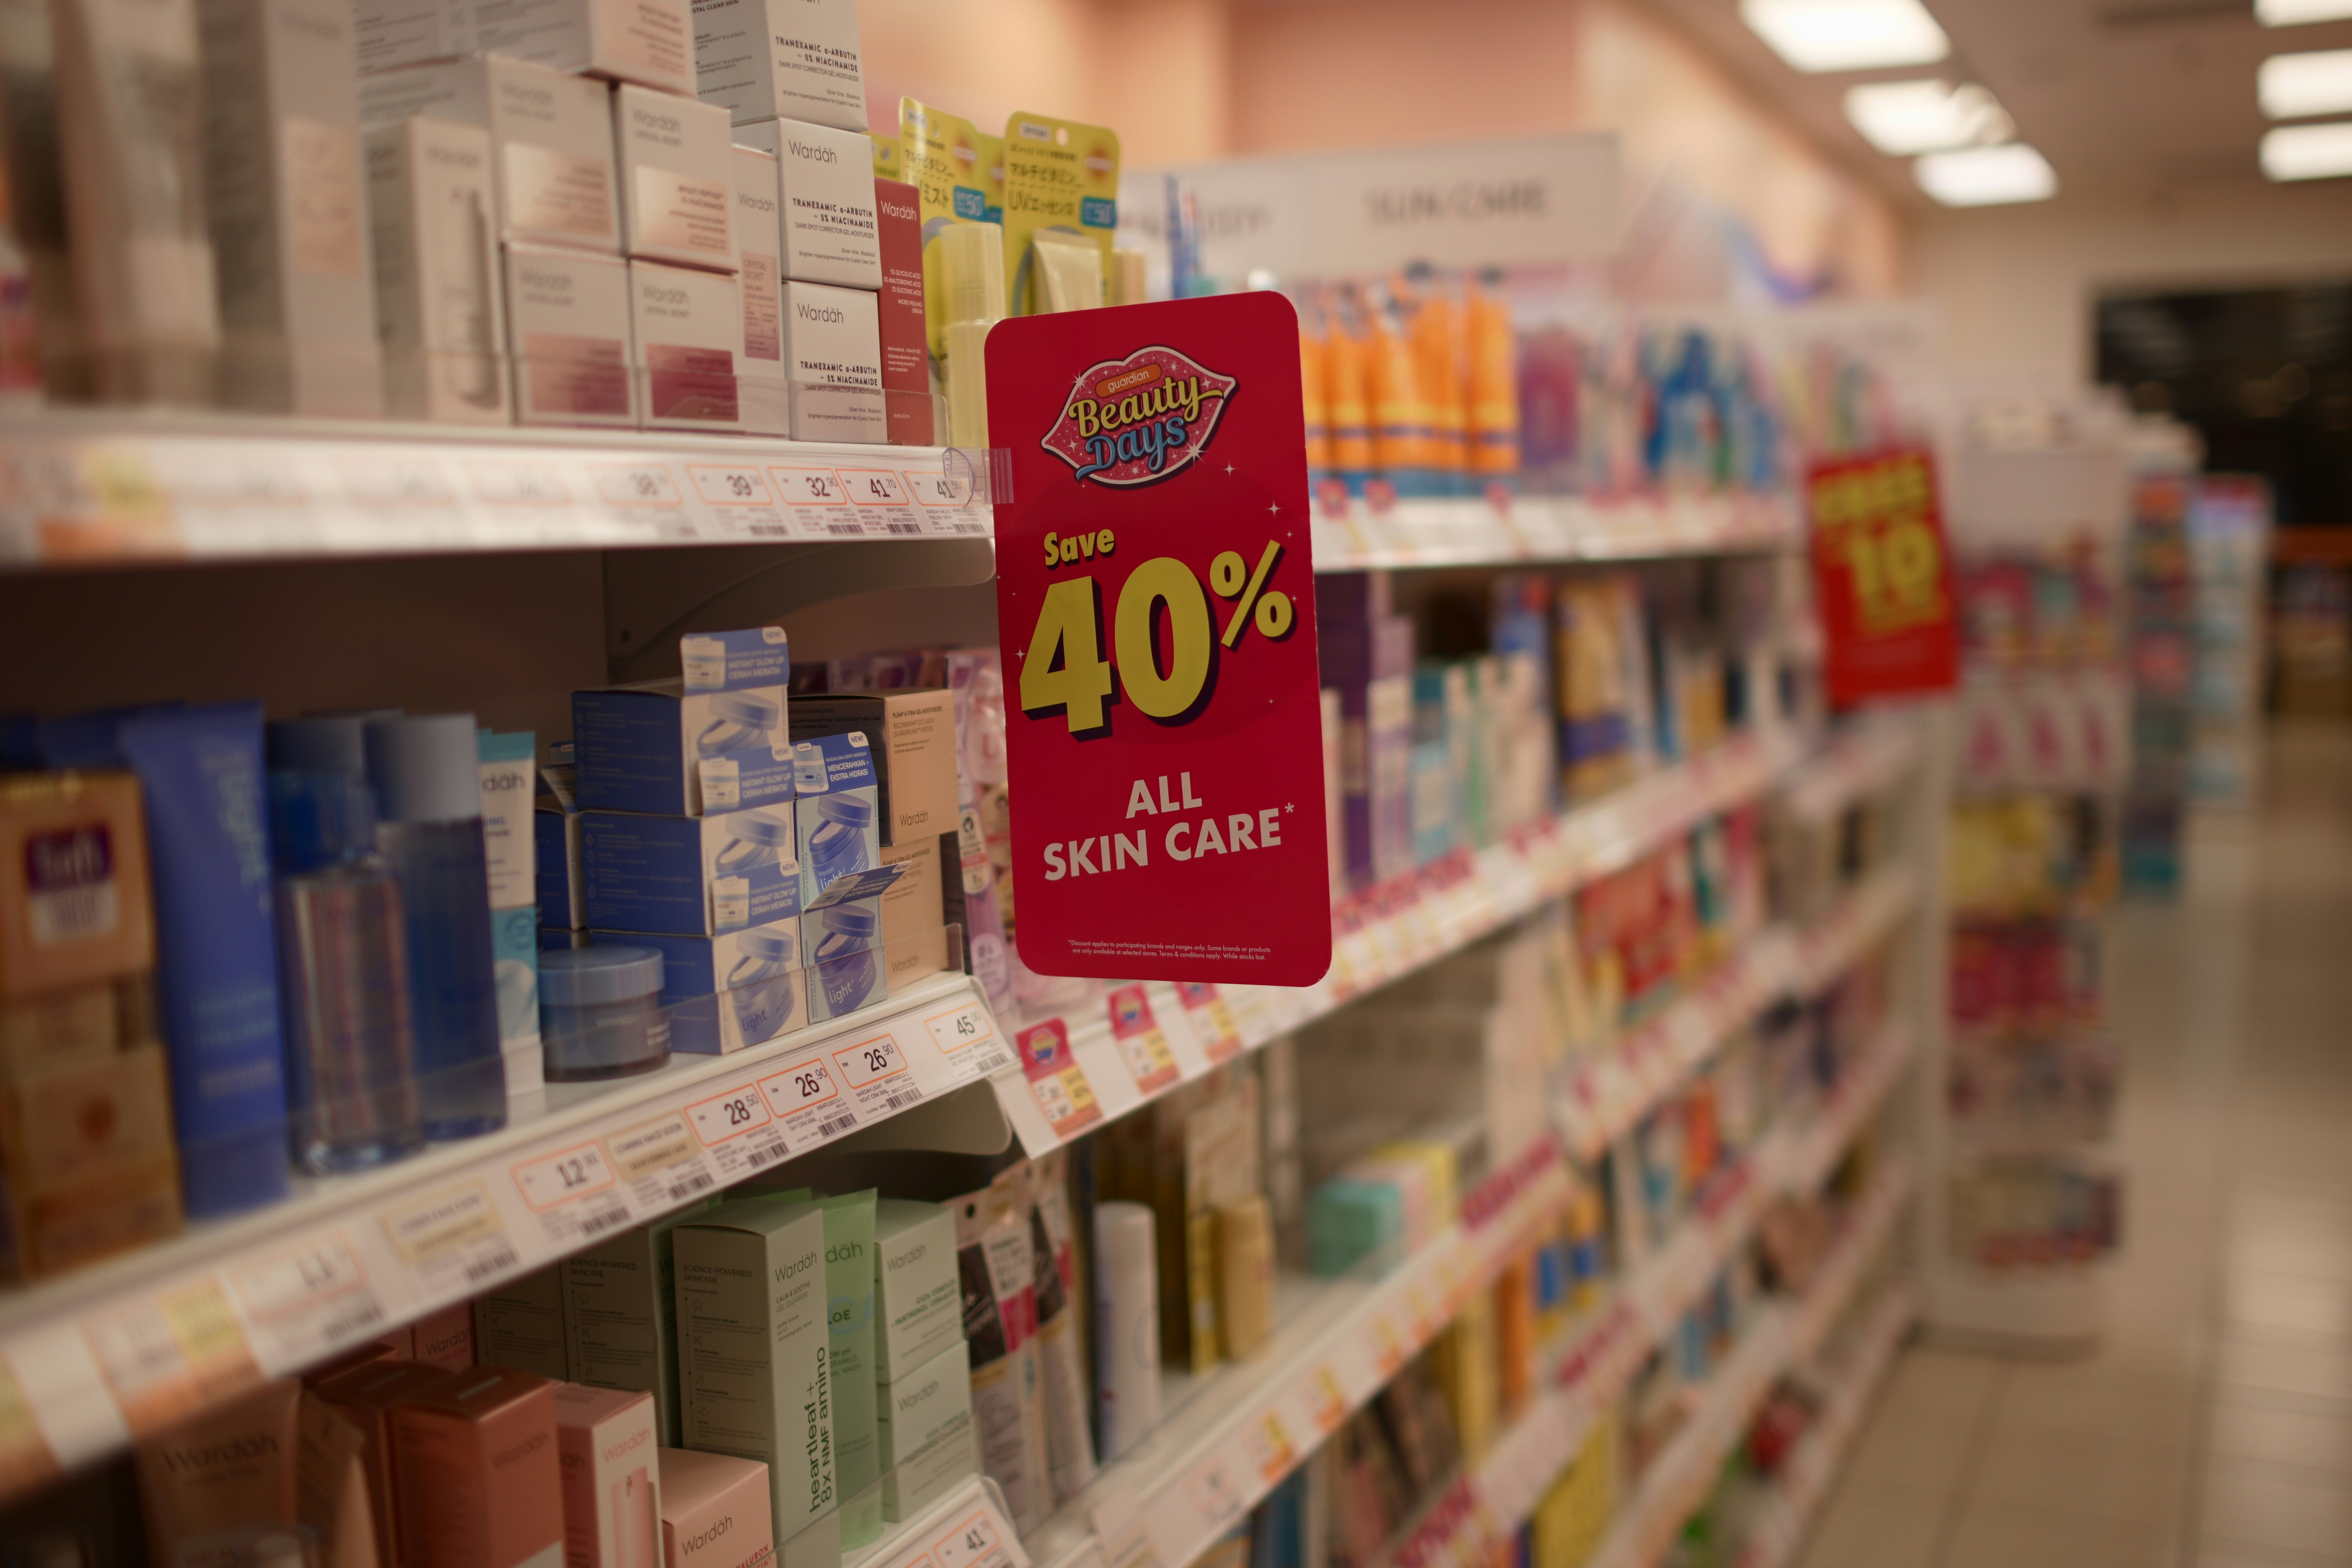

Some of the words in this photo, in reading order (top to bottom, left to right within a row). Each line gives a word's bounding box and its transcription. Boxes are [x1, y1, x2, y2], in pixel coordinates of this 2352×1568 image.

[775, 37, 821, 53] TRANEXAMIC
[779, 60, 791, 69] DARK
[803, 64, 828, 75] CORRECTOR
[836, 70, 859, 82] MOISTURIZER
[805, 54, 813, 62] 5%
[816, 56, 858, 72] NIACINAMIDE
[793, 198, 836, 212] TRANEXAMIC
[821, 214, 828, 222] 5%
[831, 216, 873, 229] NIACINAMIDE
[795, 222, 807, 230] DARK
[818, 225, 843, 234] CORRECTOR
[851, 229, 874, 239] MOISTURIZER
[814, 252, 845, 262] Hyperpigmentation
[800, 361, 843, 372] TRANEXAMIC
[837, 376, 877, 386] NIACINAMIDE
[1107, 368, 1150, 393] guardian
[1068, 376, 1224, 439] Beauty
[1076, 416, 1185, 482] Days
[1043, 528, 1115, 566] Save
[1019, 539, 1293, 733] 40%
[893, 719, 917, 729] RECOMBINANT
[828, 760, 865, 772] MENCERAHKAN
[830, 772, 849, 781] EKSTRA
[849, 768, 868, 778] HIDRASI
[1125, 771, 1203, 819] ALL
[1043, 829, 1148, 882] SKIN
[782, 863, 795, 871] NEW!
[751, 894, 772, 905] INSTANT
[773, 890, 789, 900] GLOW
[1116, 942, 1146, 950] participating
[828, 981, 852, 1004] light
[741, 1008, 768, 1034] light
[569, 1258, 637, 1270] SCIENCE-POWERED
[683, 1264, 752, 1278] SCIENCE-POWERED
[776, 1293, 789, 1304] CALM
[793, 1280, 811, 1293] SOOTHE
[777, 1304, 785, 1313] GEL
[786, 1291, 808, 1308] CLEANSER
[803, 1320, 812, 1329] tested
[816, 1347, 829, 1419] amino
[820, 1425, 831, 1468] NMF
[804, 1400, 821, 1514] heartleaf
